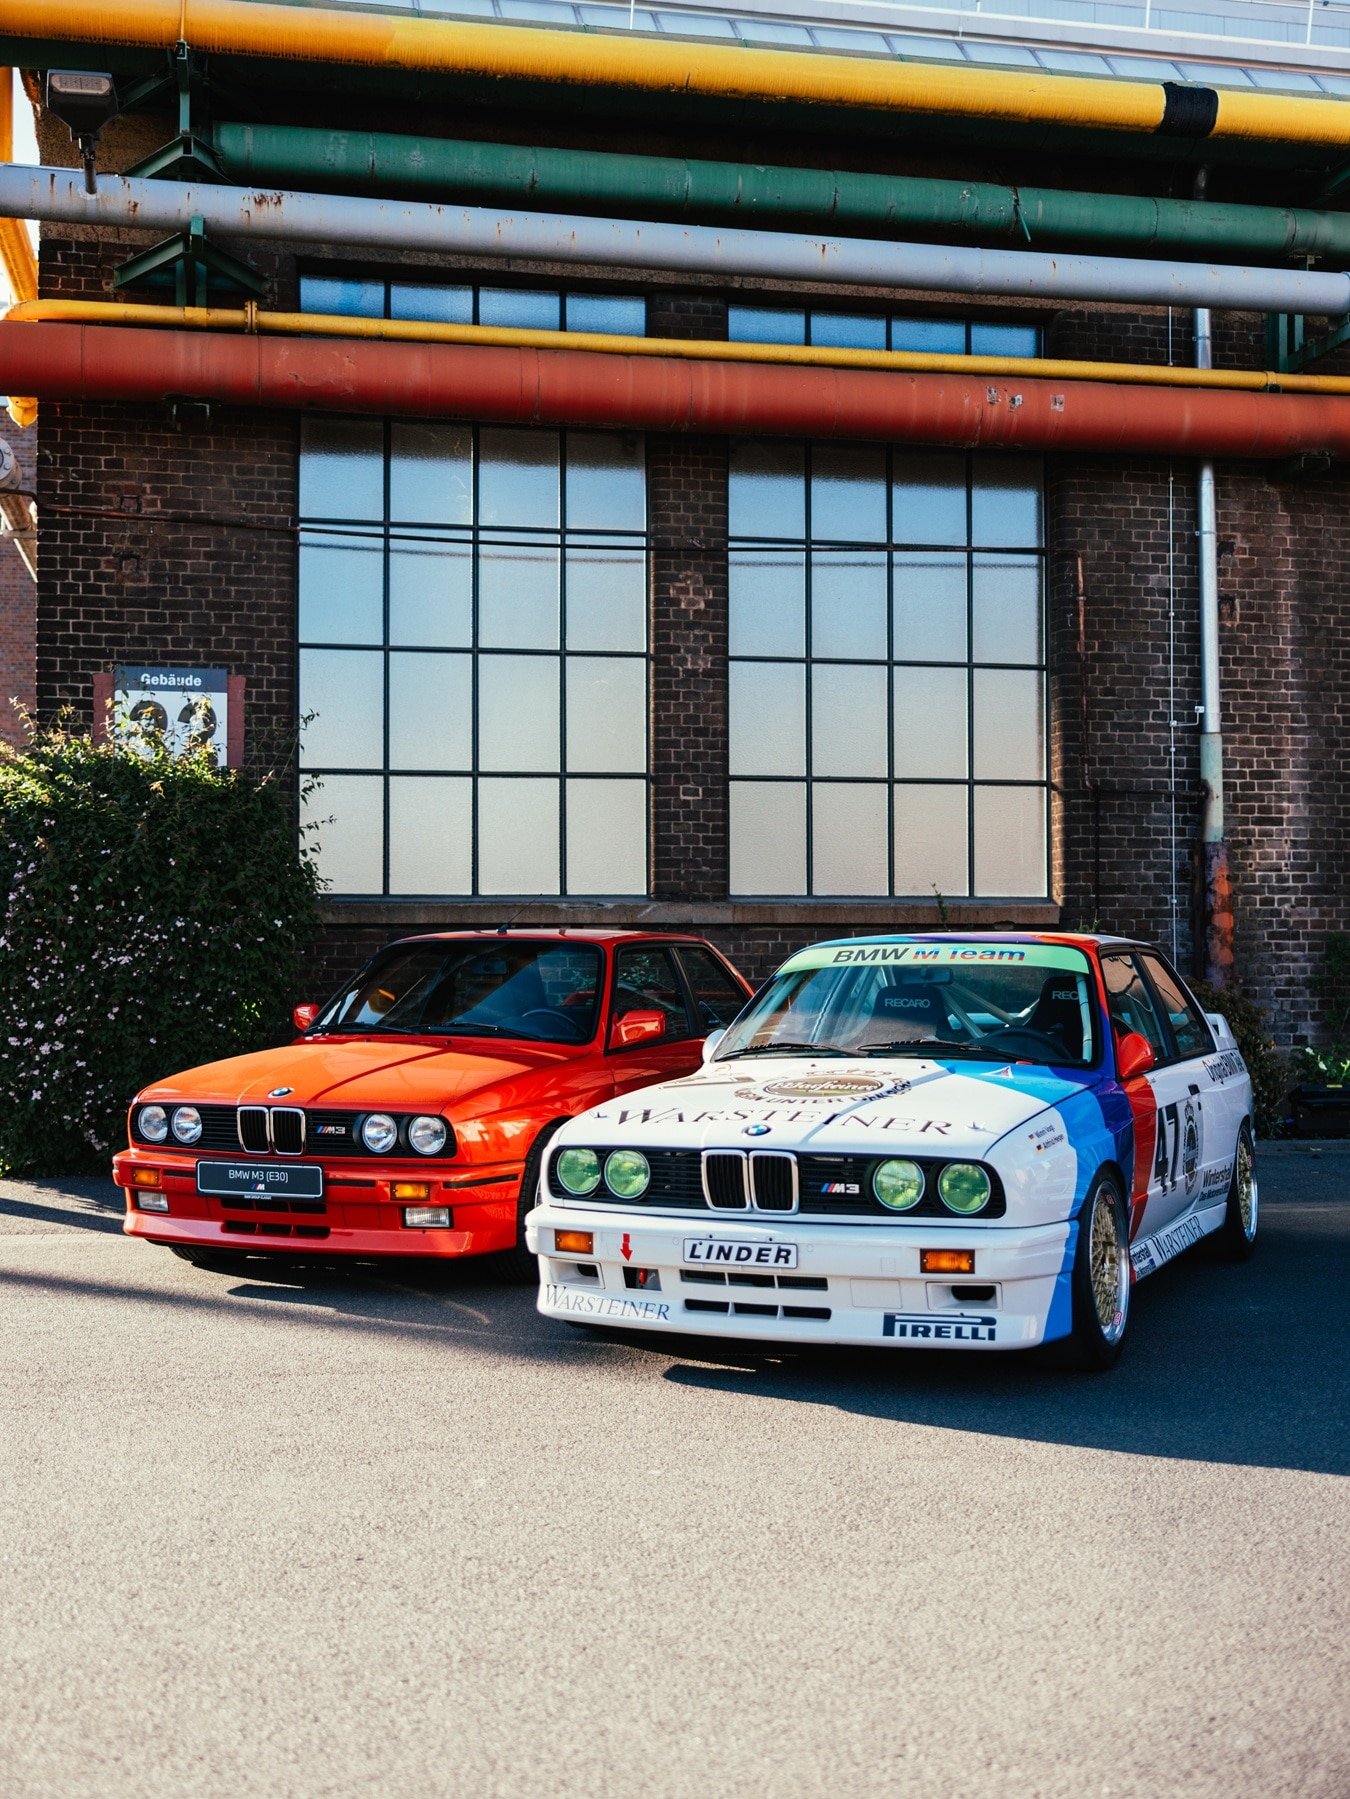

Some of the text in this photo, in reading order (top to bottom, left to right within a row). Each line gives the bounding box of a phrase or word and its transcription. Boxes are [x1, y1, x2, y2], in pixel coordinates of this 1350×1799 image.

[140, 673, 202, 687] Gebäude
[832, 946, 1026, 963] BMW M Team
[884, 998, 931, 1008] RECARO
[1052, 990, 1079, 1001] REC
[616, 1106, 953, 1136] WARSTEINER
[325, 1126, 346, 1135] M3
[1154, 1103, 1179, 1198] 47
[228, 1169, 289, 1184] BMW M3 (E30)
[830, 1183, 860, 1194] M3
[1149, 1215, 1205, 1264] WARSTEINER
[688, 1243, 793, 1265] LINDER
[545, 1283, 670, 1321] WARSTEINER
[883, 1312, 997, 1341] PIRELLI
